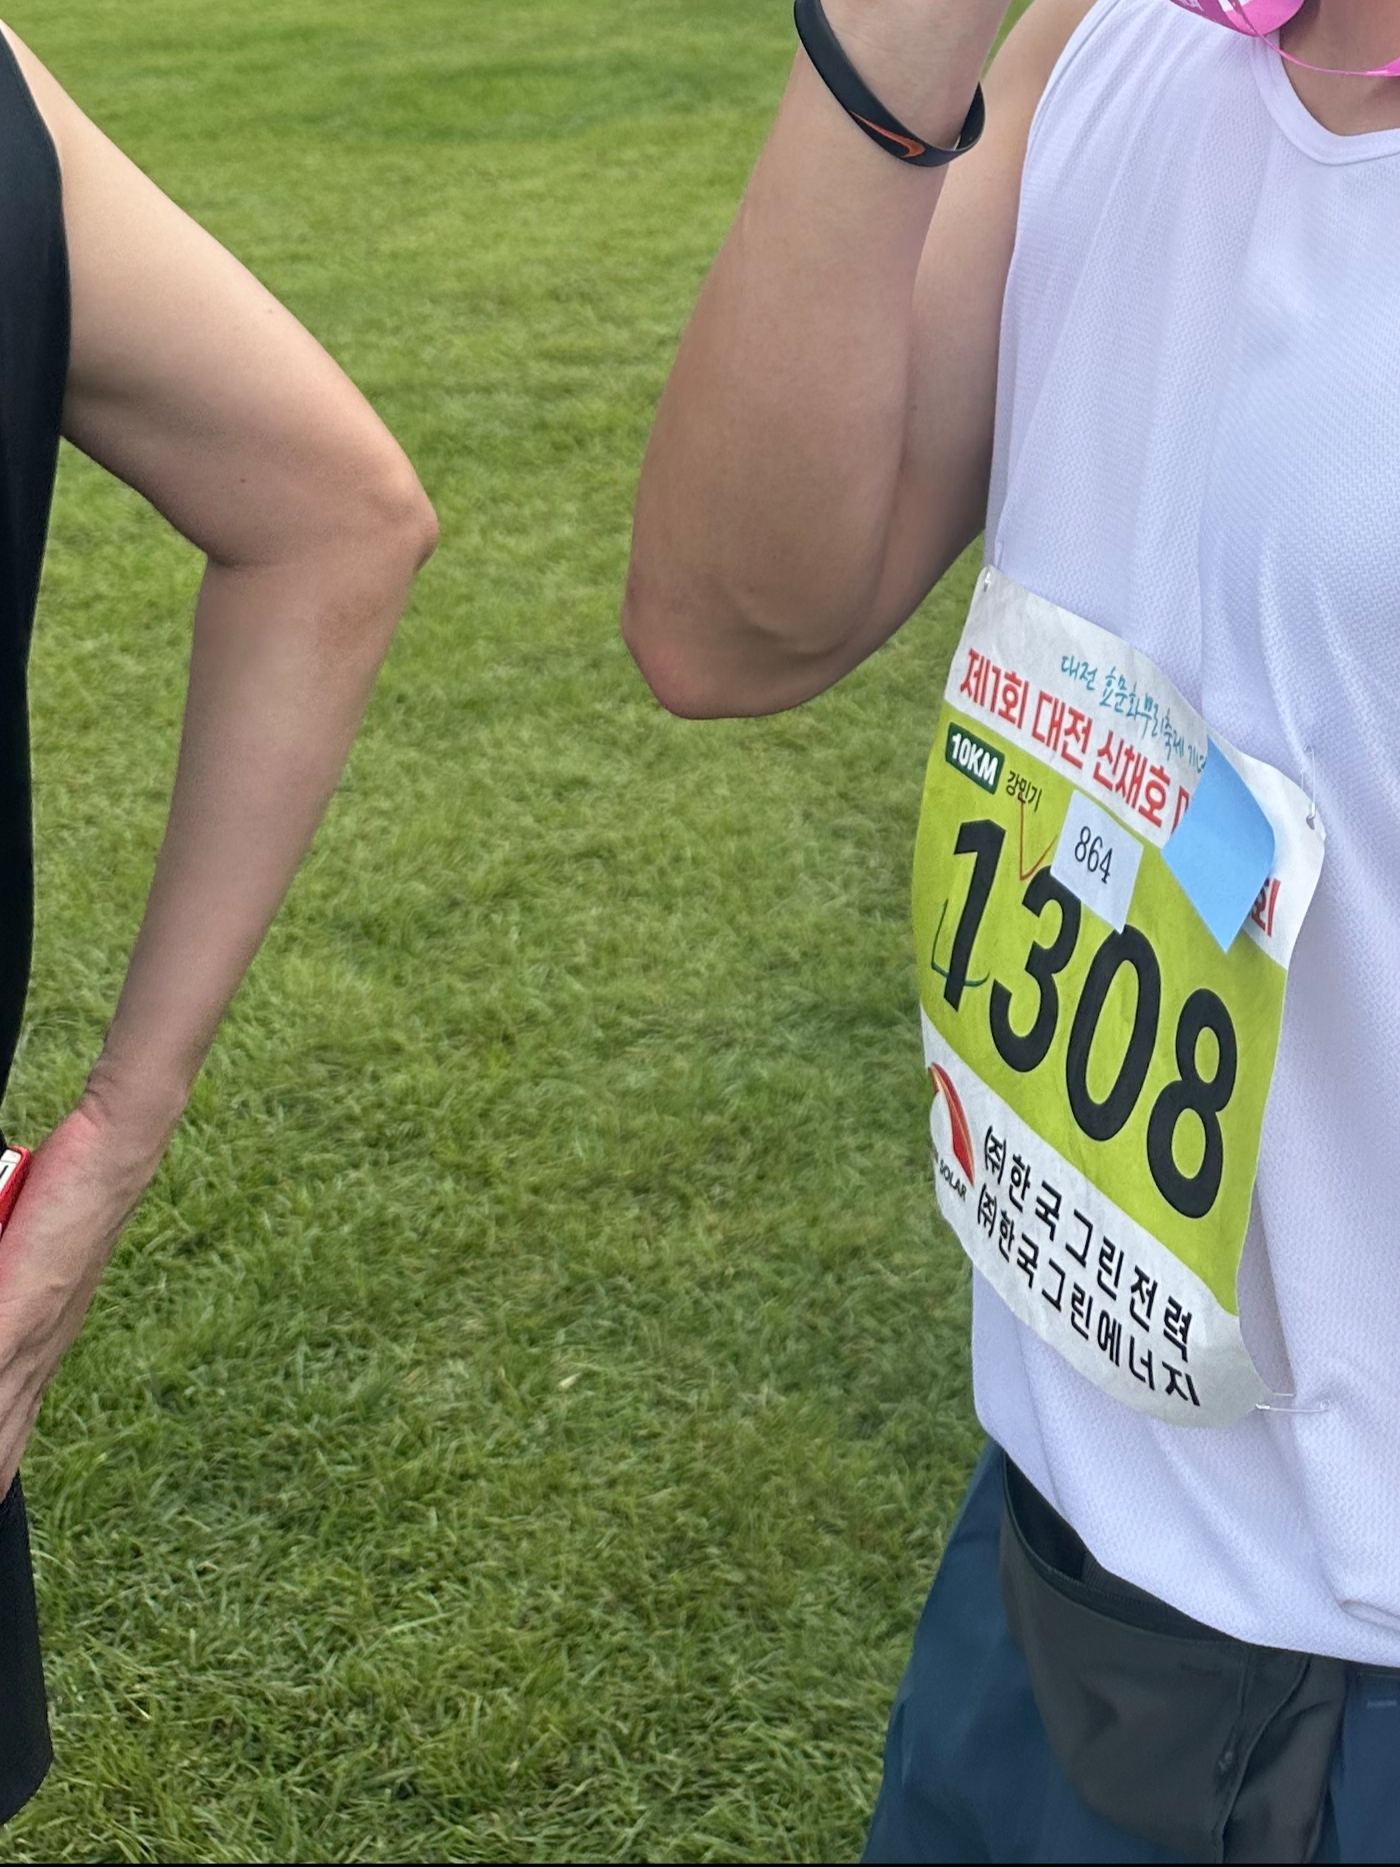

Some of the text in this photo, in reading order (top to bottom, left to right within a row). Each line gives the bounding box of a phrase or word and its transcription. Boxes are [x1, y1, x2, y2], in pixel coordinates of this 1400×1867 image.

[1061, 654, 1098, 691] 대전
[1099, 666, 1186, 762] 효문화뿌리축제
[952, 733, 998, 786] 10KM
[959, 648, 1029, 730] 제1회
[1031, 691, 1093, 771] 대전
[1093, 729, 1172, 829] 신채호
[1006, 770, 1042, 813] 강민기
[1074, 826, 1113, 885] 864
[943, 819, 1238, 1219] 1308
[940, 1158, 967, 1202] SOLAR
